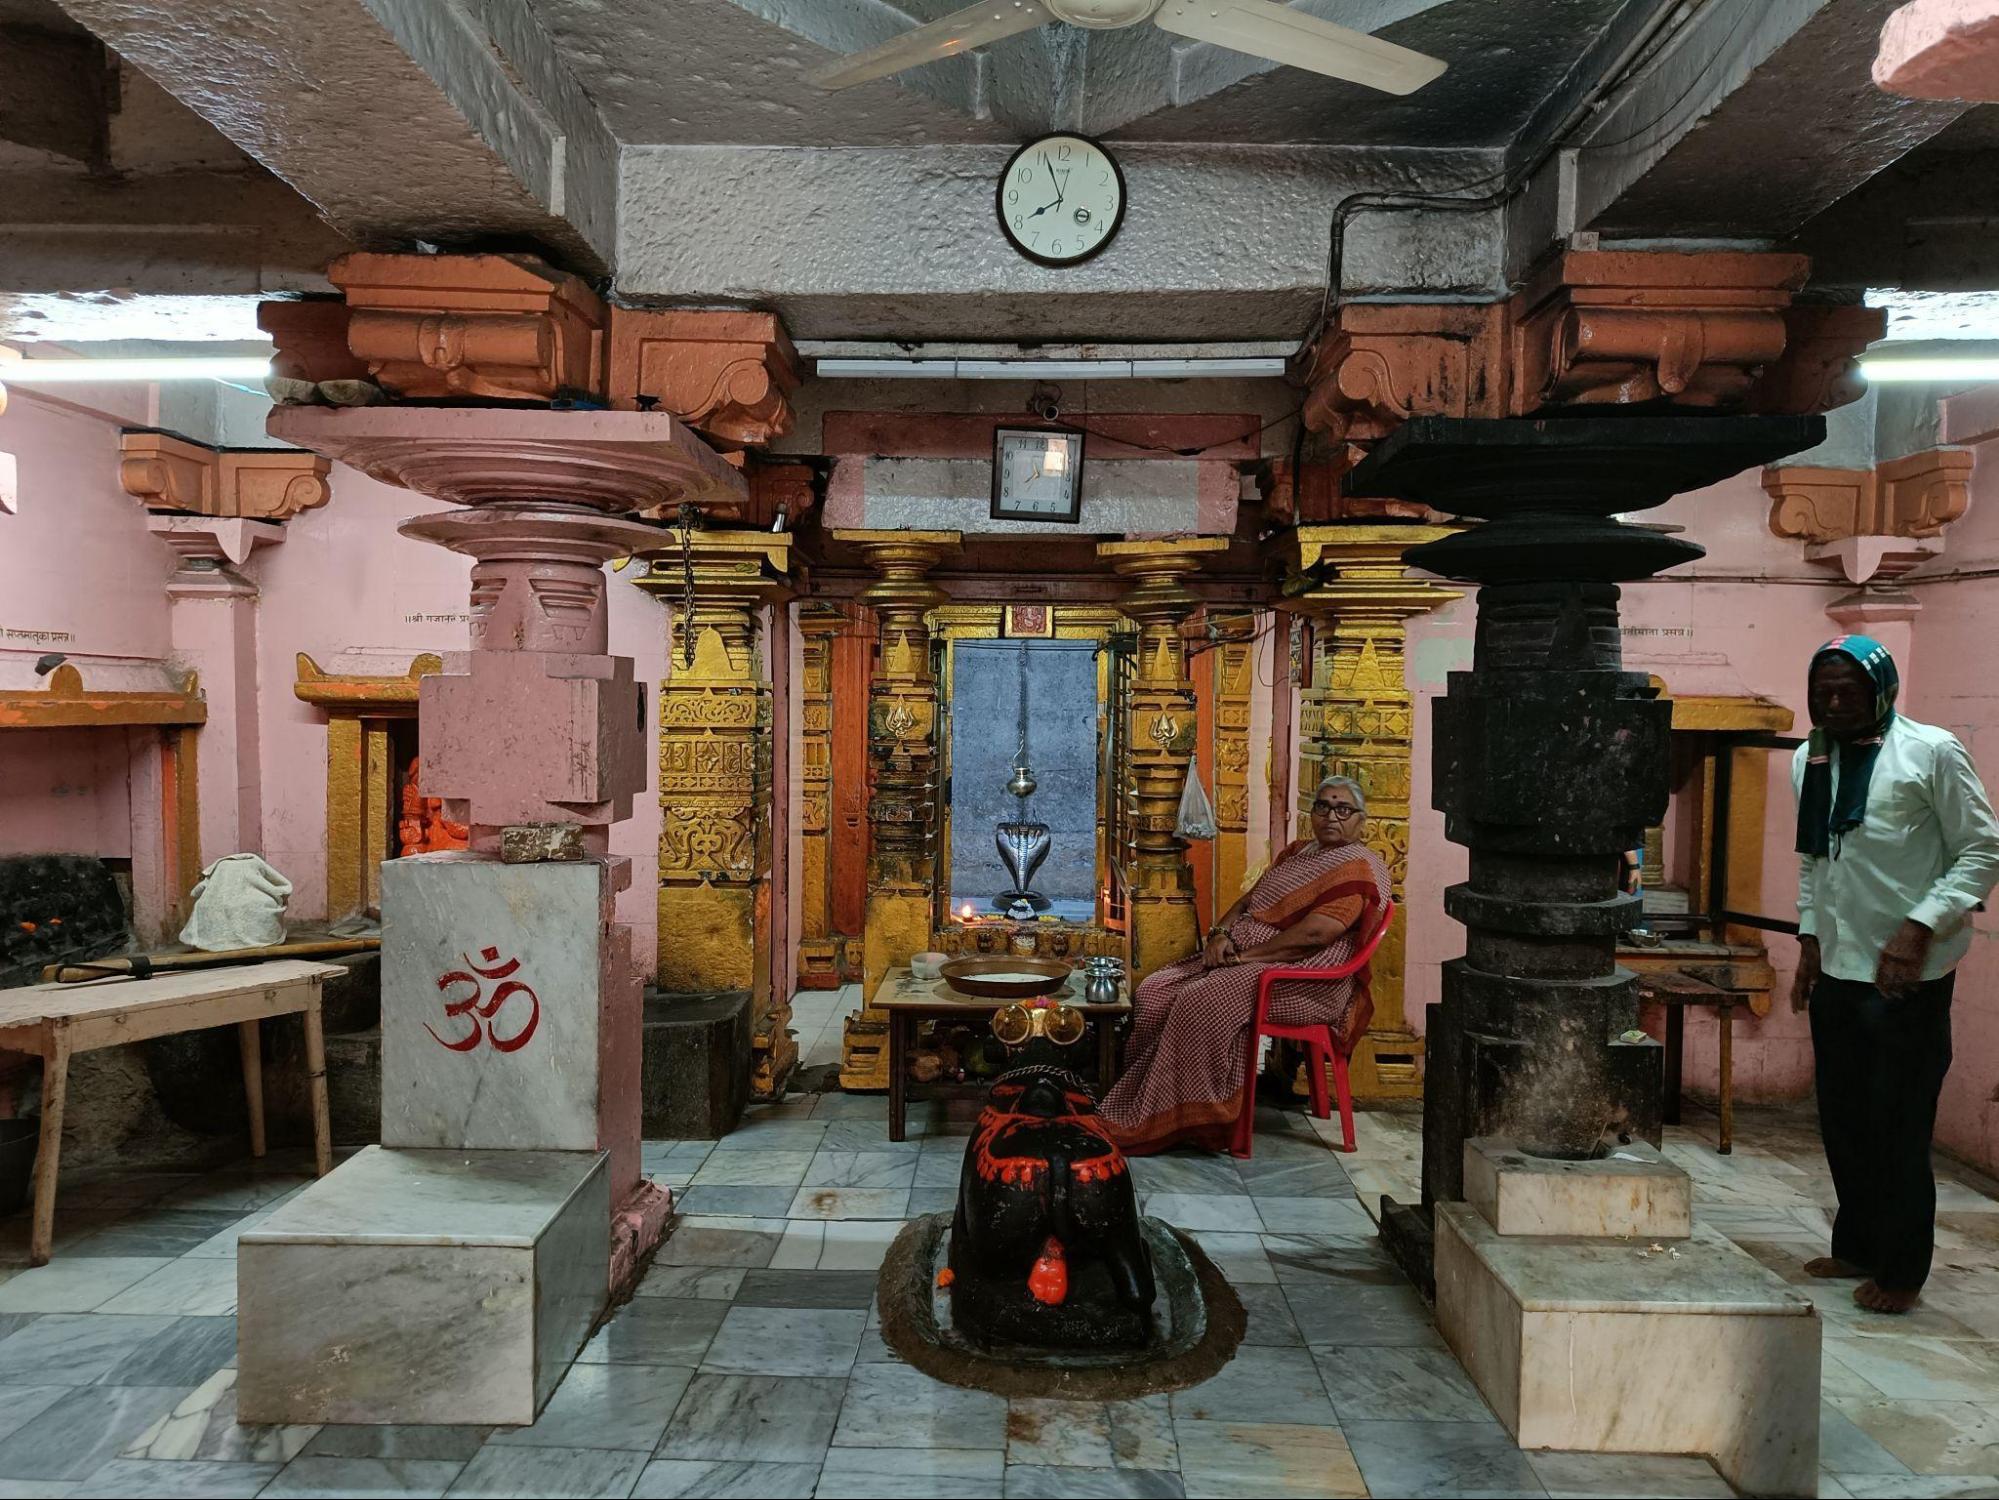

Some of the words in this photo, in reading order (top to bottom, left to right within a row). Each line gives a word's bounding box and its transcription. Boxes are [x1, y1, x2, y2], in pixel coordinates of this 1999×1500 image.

[1058, 145, 1071, 161] 12
[1017, 168, 1032, 184] 10
[1098, 170, 1109, 187] 2
[1008, 189, 1019, 205] 9
[1104, 194, 1114, 211] 3
[1013, 214, 1023, 230] 8
[1094, 219, 1104, 234] 4
[1031, 231, 1040, 247] 7
[1051, 239, 1062, 255] 6
[1076, 234, 1085, 250] 5
[1014, 501, 1021, 510] 7
[1033, 501, 1039, 511] 6
[1050, 502, 1056, 512] 5
